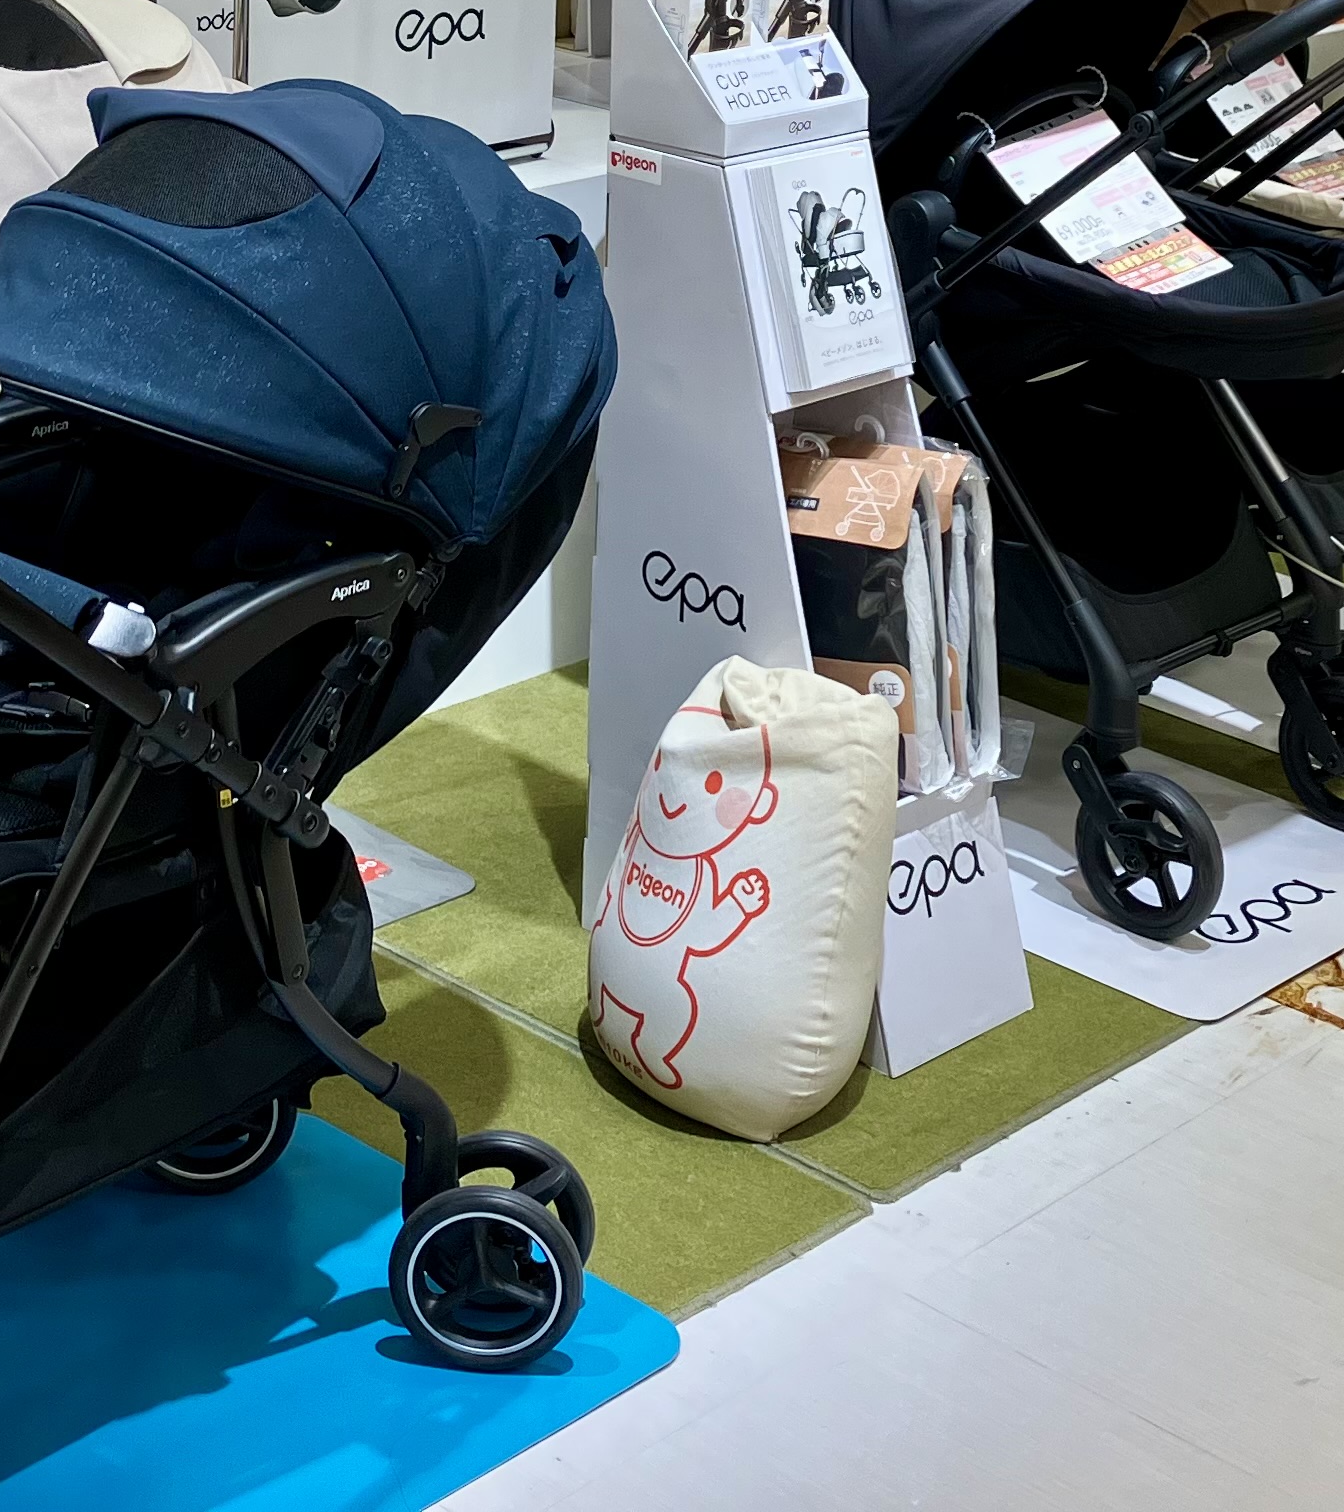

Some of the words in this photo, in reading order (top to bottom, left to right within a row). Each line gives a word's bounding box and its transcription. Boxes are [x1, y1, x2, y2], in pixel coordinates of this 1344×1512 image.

[395, 7, 486, 60] epa
[715, 70, 749, 91] CUP
[724, 85, 792, 111] HOLDER
[788, 120, 812, 136] epa
[848, 308, 875, 327] epa
[31, 418, 70, 438] Aprica
[330, 577, 371, 603] Aprica
[641, 550, 747, 633] epa
[886, 837, 986, 919] epa
[1196, 878, 1337, 944] epa
